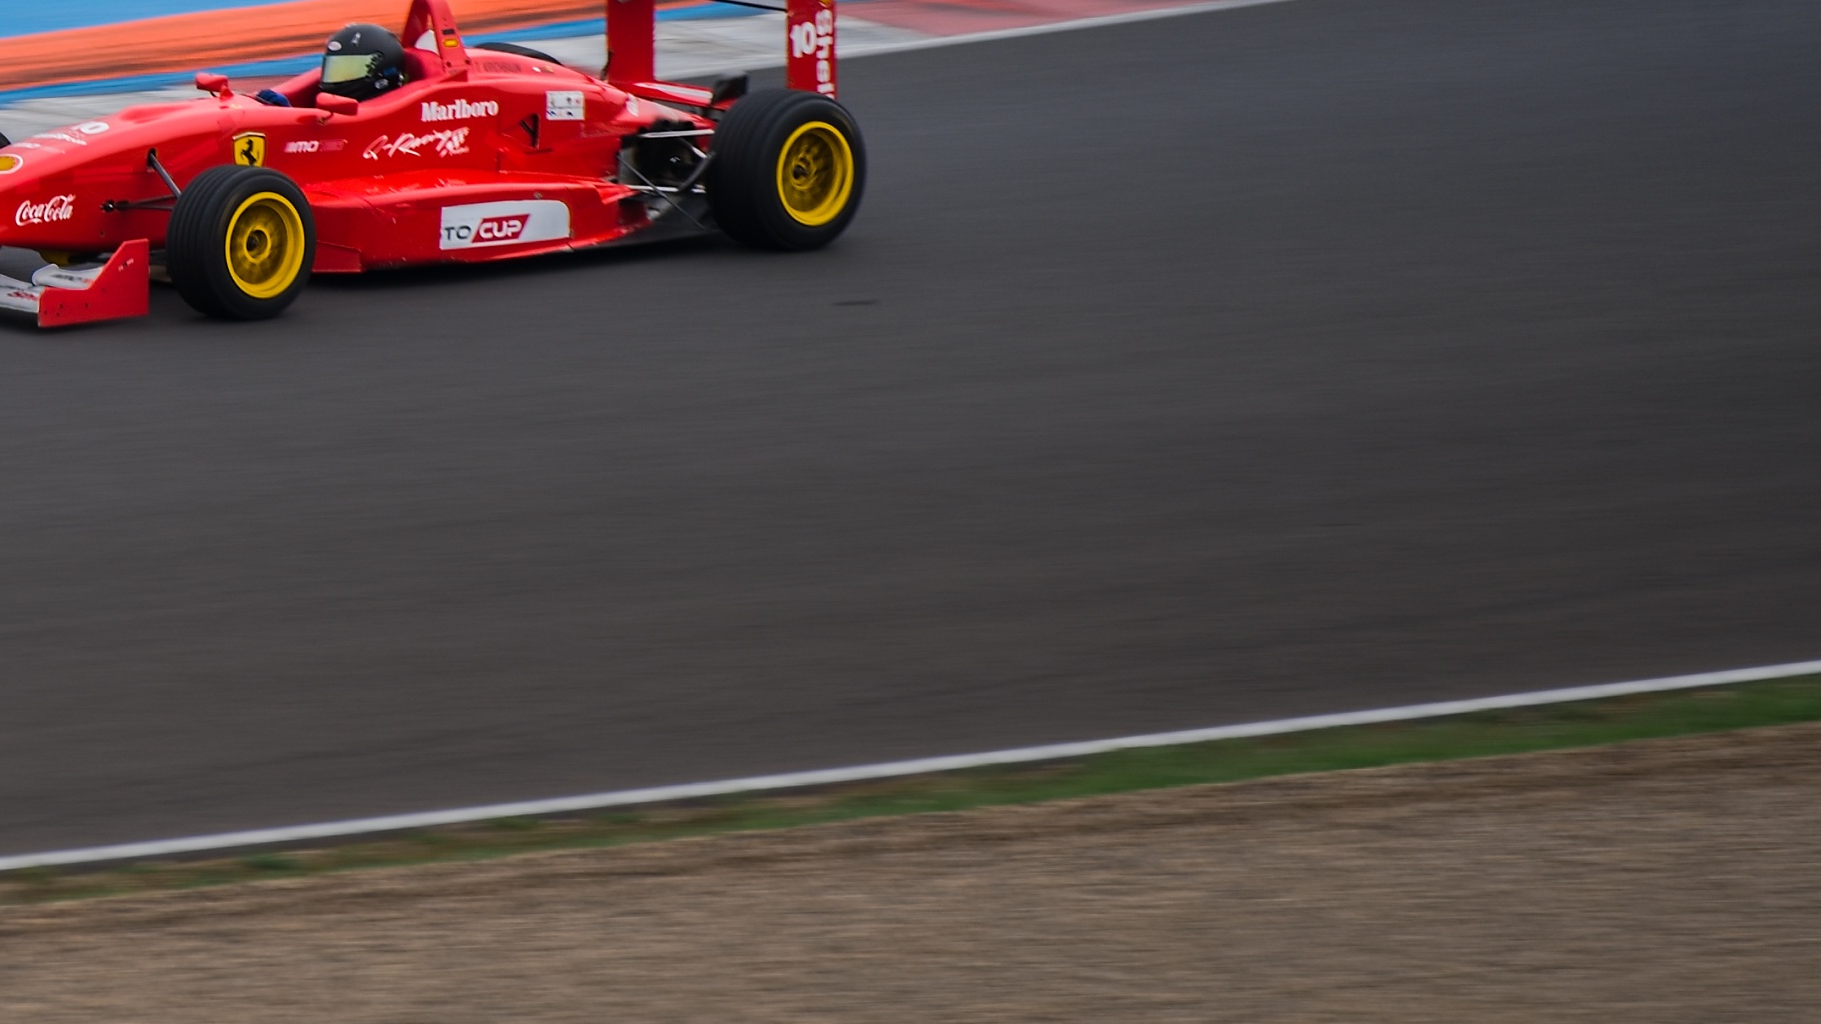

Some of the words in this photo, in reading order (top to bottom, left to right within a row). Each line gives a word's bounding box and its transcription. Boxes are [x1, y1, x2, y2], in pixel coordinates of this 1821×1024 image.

[790, 22, 816, 58] 10
[421, 99, 499, 122] Marlboro
[445, 226, 472, 241] TO
[479, 219, 523, 239] CUP
